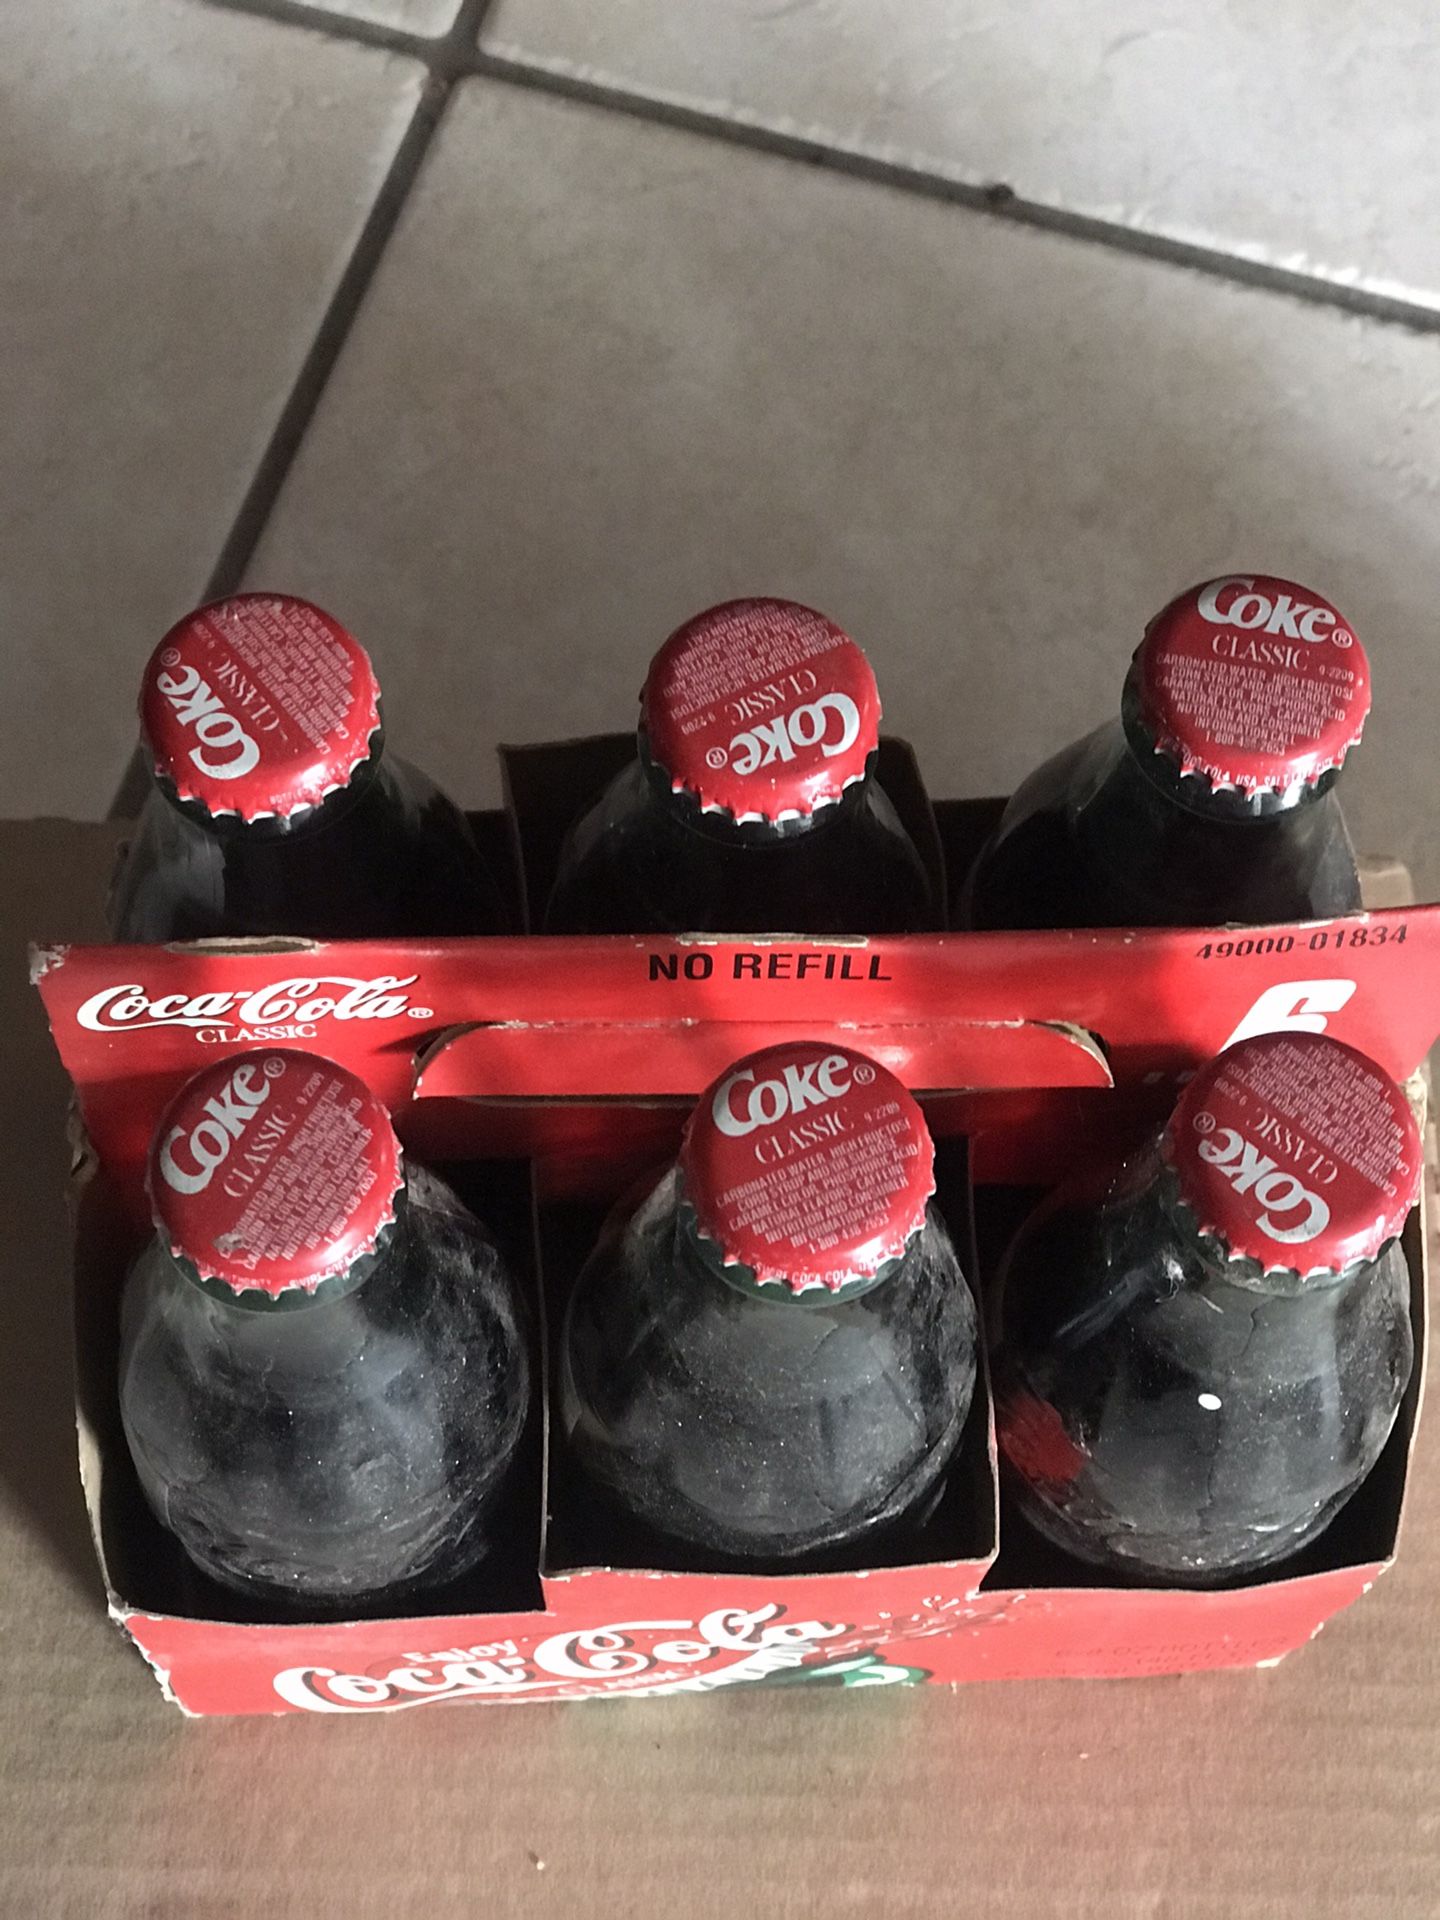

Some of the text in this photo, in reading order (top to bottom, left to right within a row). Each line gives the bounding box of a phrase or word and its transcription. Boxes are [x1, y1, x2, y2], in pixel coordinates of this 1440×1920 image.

[1197, 579, 1336, 642] Coke
[1210, 633, 1310, 671] CLASSIC
[157, 665, 259, 779] Coke
[207, 649, 282, 736] CLASSIC
[722, 666, 818, 726] CLASSIC
[1236, 712, 1258, 727] AND
[729, 693, 859, 775] Coke
[649, 953, 892, 981] NO REFILL
[1197, 924, 1408, 960] 49000-01834
[77, 974, 418, 1032] Coca-Cola
[195, 1023, 318, 1044] CLASSIC
[712, 1055, 850, 1136] Coke
[159, 1064, 270, 1194] Coke
[220, 1101, 297, 1201] CLASSIC
[752, 1106, 856, 1166] CLASSIC
[1244, 1106, 1341, 1187] CLASSIC
[824, 1199, 847, 1218] AND
[1197, 1127, 1330, 1243] Coke
[402, 1638, 519, 1665] Enjoy
